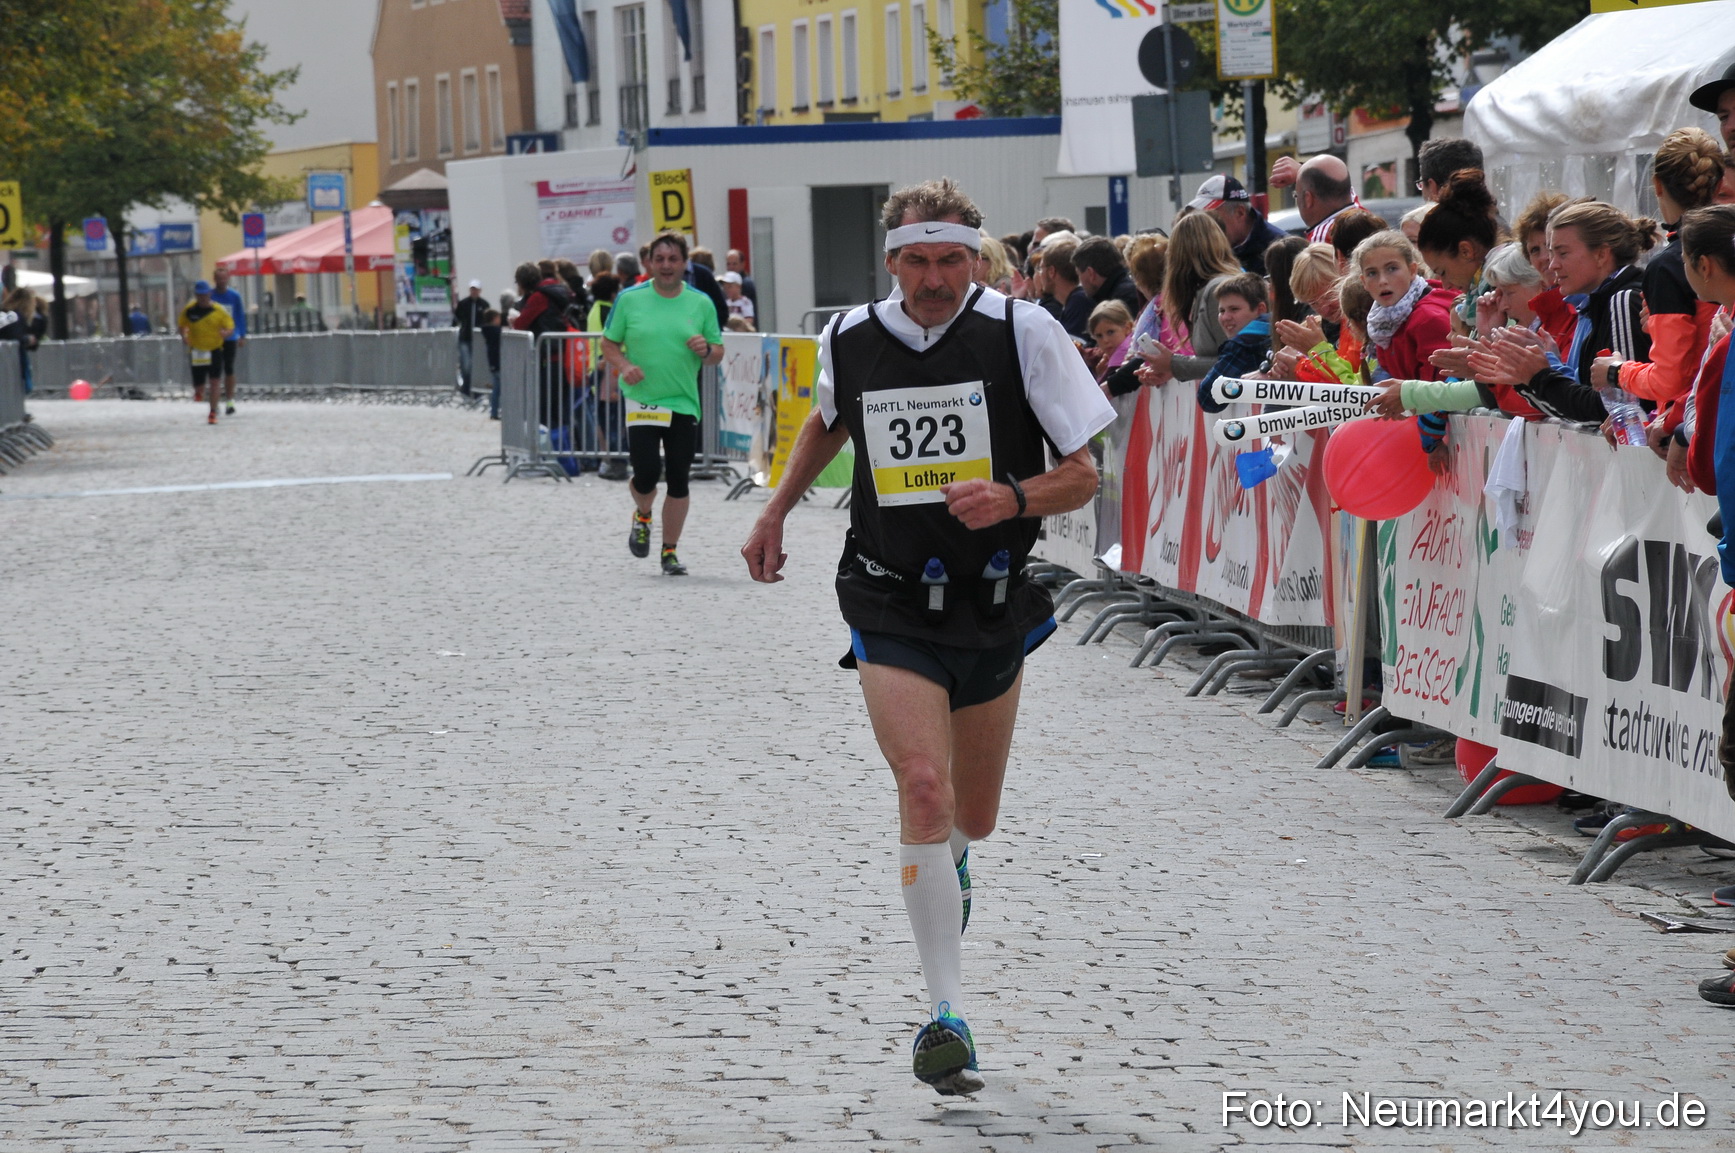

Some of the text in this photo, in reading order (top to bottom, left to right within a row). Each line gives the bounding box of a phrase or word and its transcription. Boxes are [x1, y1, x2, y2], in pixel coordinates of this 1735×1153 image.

[0, 185, 14, 197] ck
[653, 172, 688, 186] Block
[662, 190, 685, 222] D
[866, 397, 964, 414] PARTL Neumarkt
[1255, 382, 1305, 401] BMW
[888, 414, 966, 461] 323
[904, 470, 956, 488] Lothar
[1393, 644, 1456, 705] BESSER
[1497, 643, 1510, 676] Ha
[1503, 695, 1542, 726] tungen
[1541, 705, 1556, 730] die
[1692, 728, 1726, 782] neu
